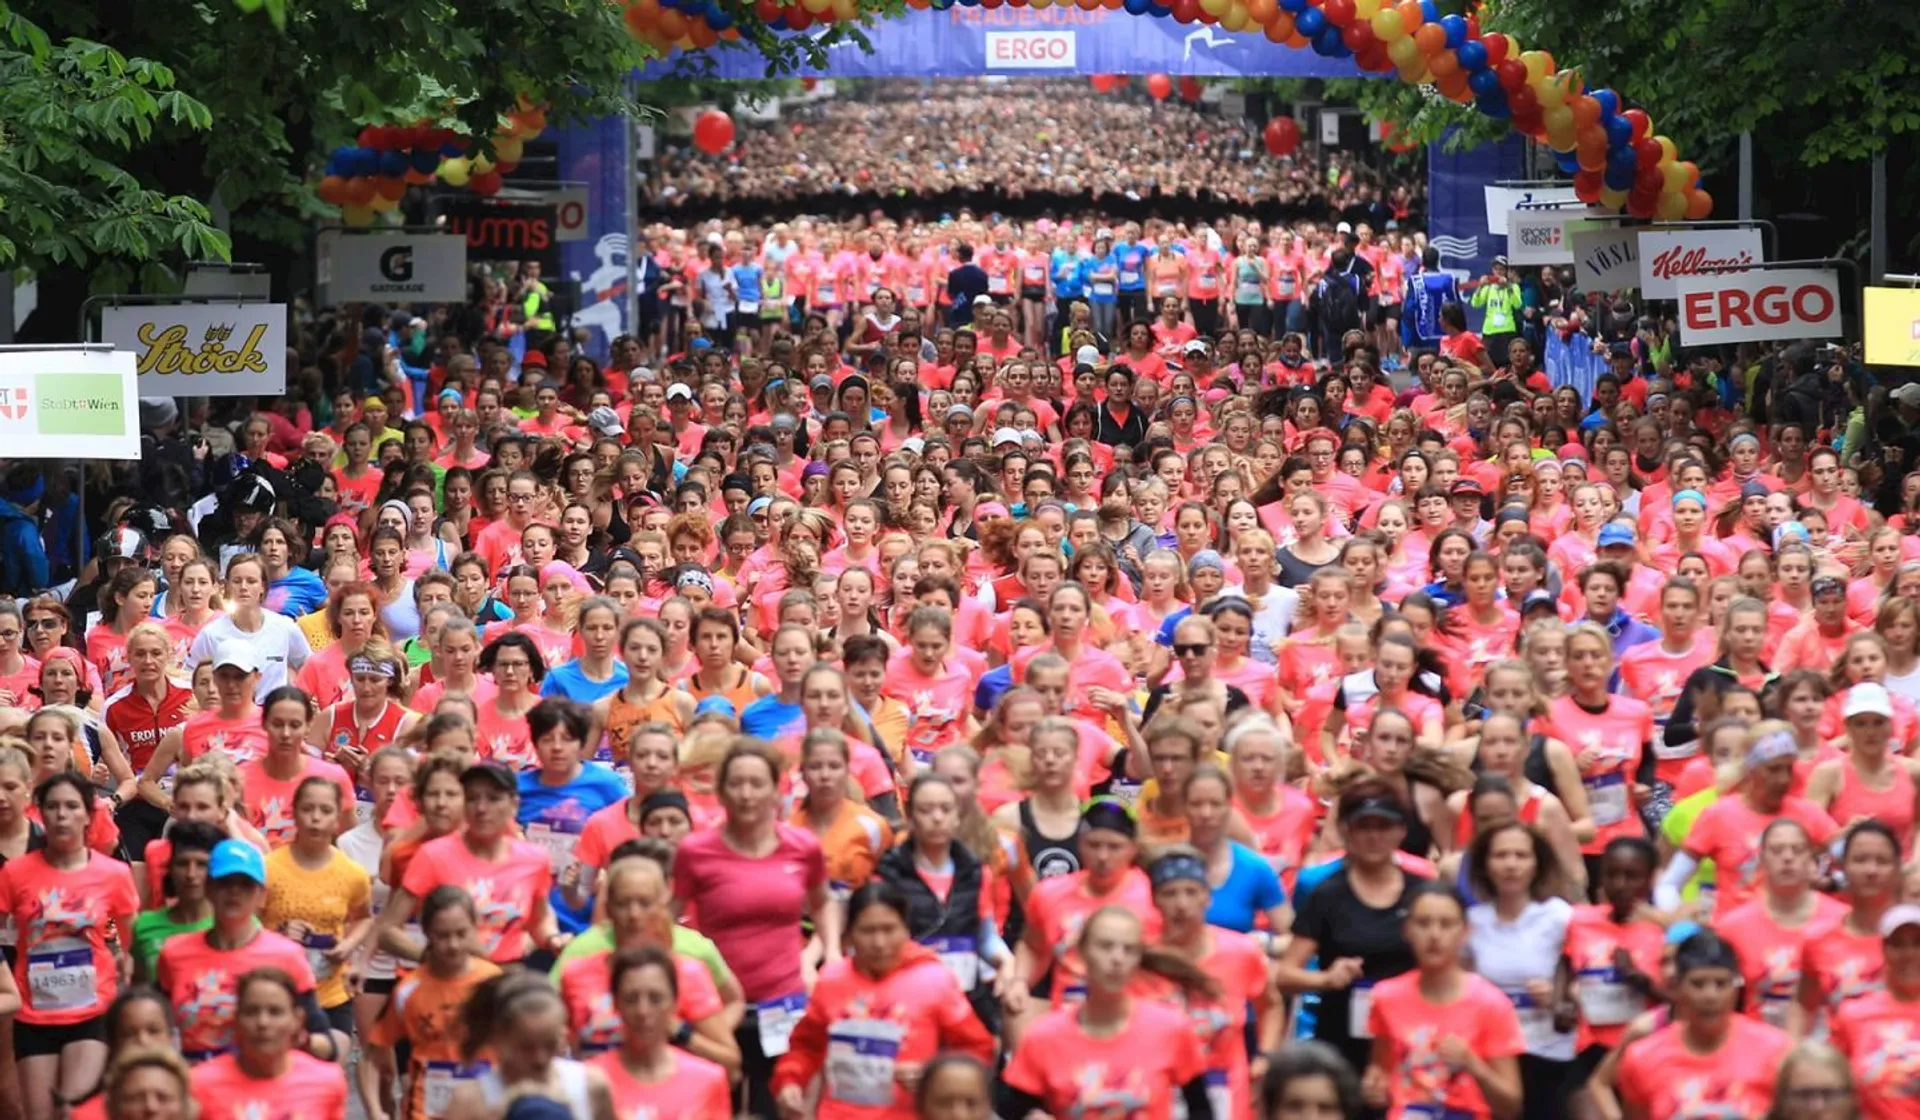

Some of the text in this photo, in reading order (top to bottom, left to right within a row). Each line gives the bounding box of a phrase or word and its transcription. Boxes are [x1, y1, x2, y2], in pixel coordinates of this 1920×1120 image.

[995, 38, 1068, 60] ERGO
[1520, 227, 1551, 237] SPORT
[1585, 241, 1636, 277] VÖSL
[1685, 284, 1834, 330] ERGO
[137, 322, 269, 375] Ströck
[87, 397, 119, 410] Wien
[130, 726, 176, 743] ERDIN
